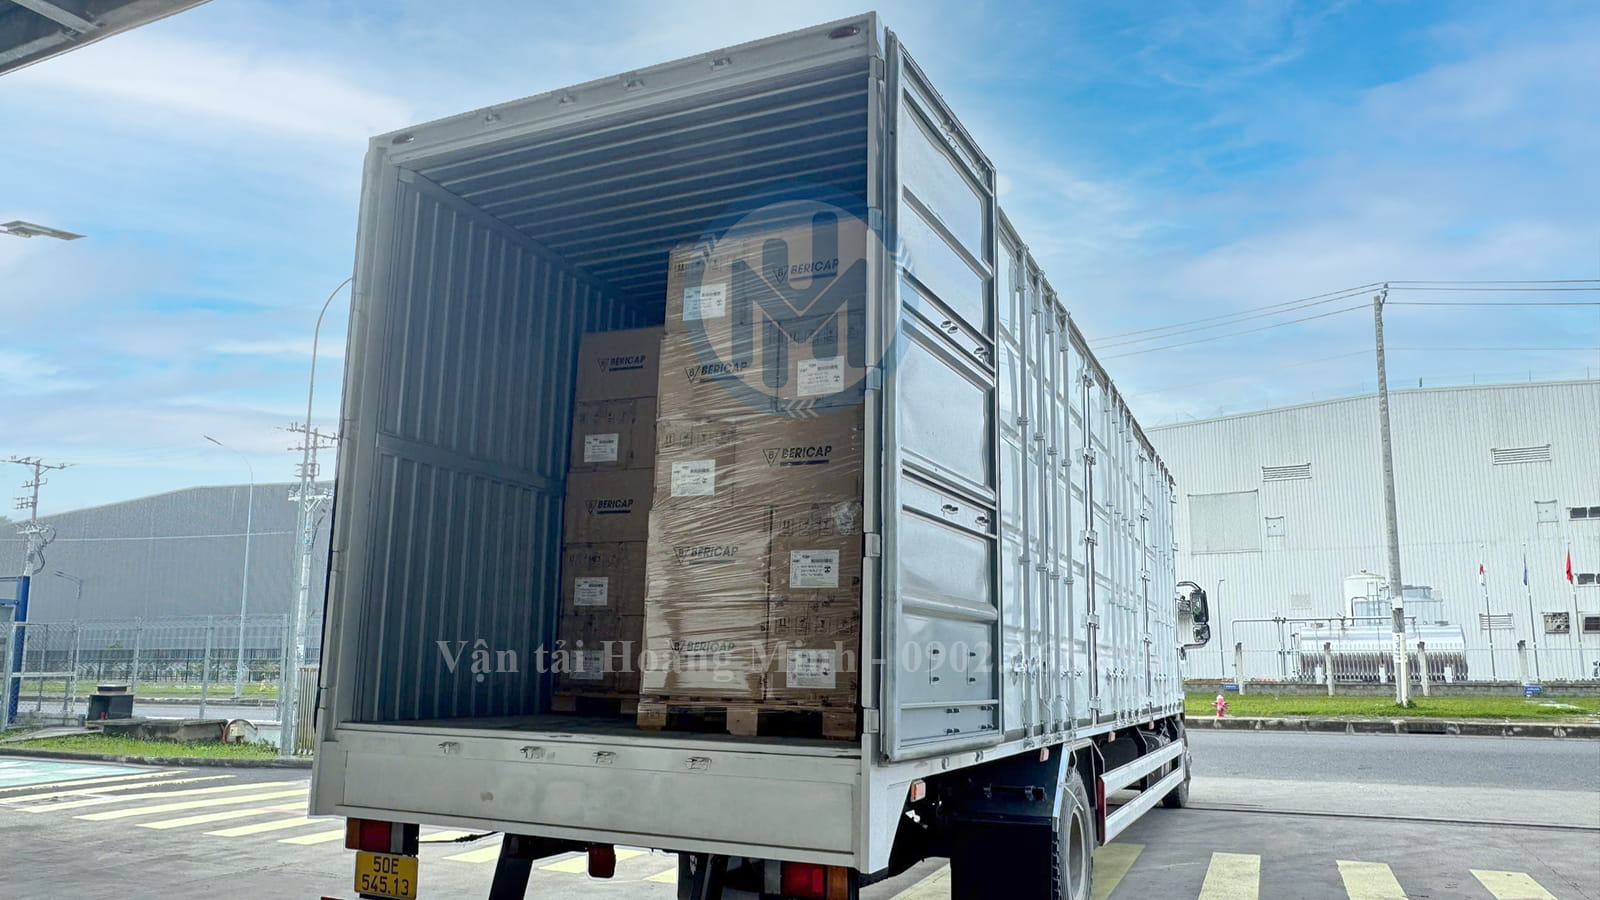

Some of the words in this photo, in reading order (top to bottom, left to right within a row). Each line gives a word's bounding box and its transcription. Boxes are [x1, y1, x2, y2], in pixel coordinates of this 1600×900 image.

[790, 258, 839, 275] BERICAP
[609, 355, 646, 366] BERICAP
[701, 361, 748, 376] BERICAP
[781, 446, 832, 459] BERICAP
[597, 499, 634, 509] BERICAP
[690, 545, 739, 558] BERICAP
[373, 856, 399, 875] 50E
[361, 874, 409, 896] 545.13
